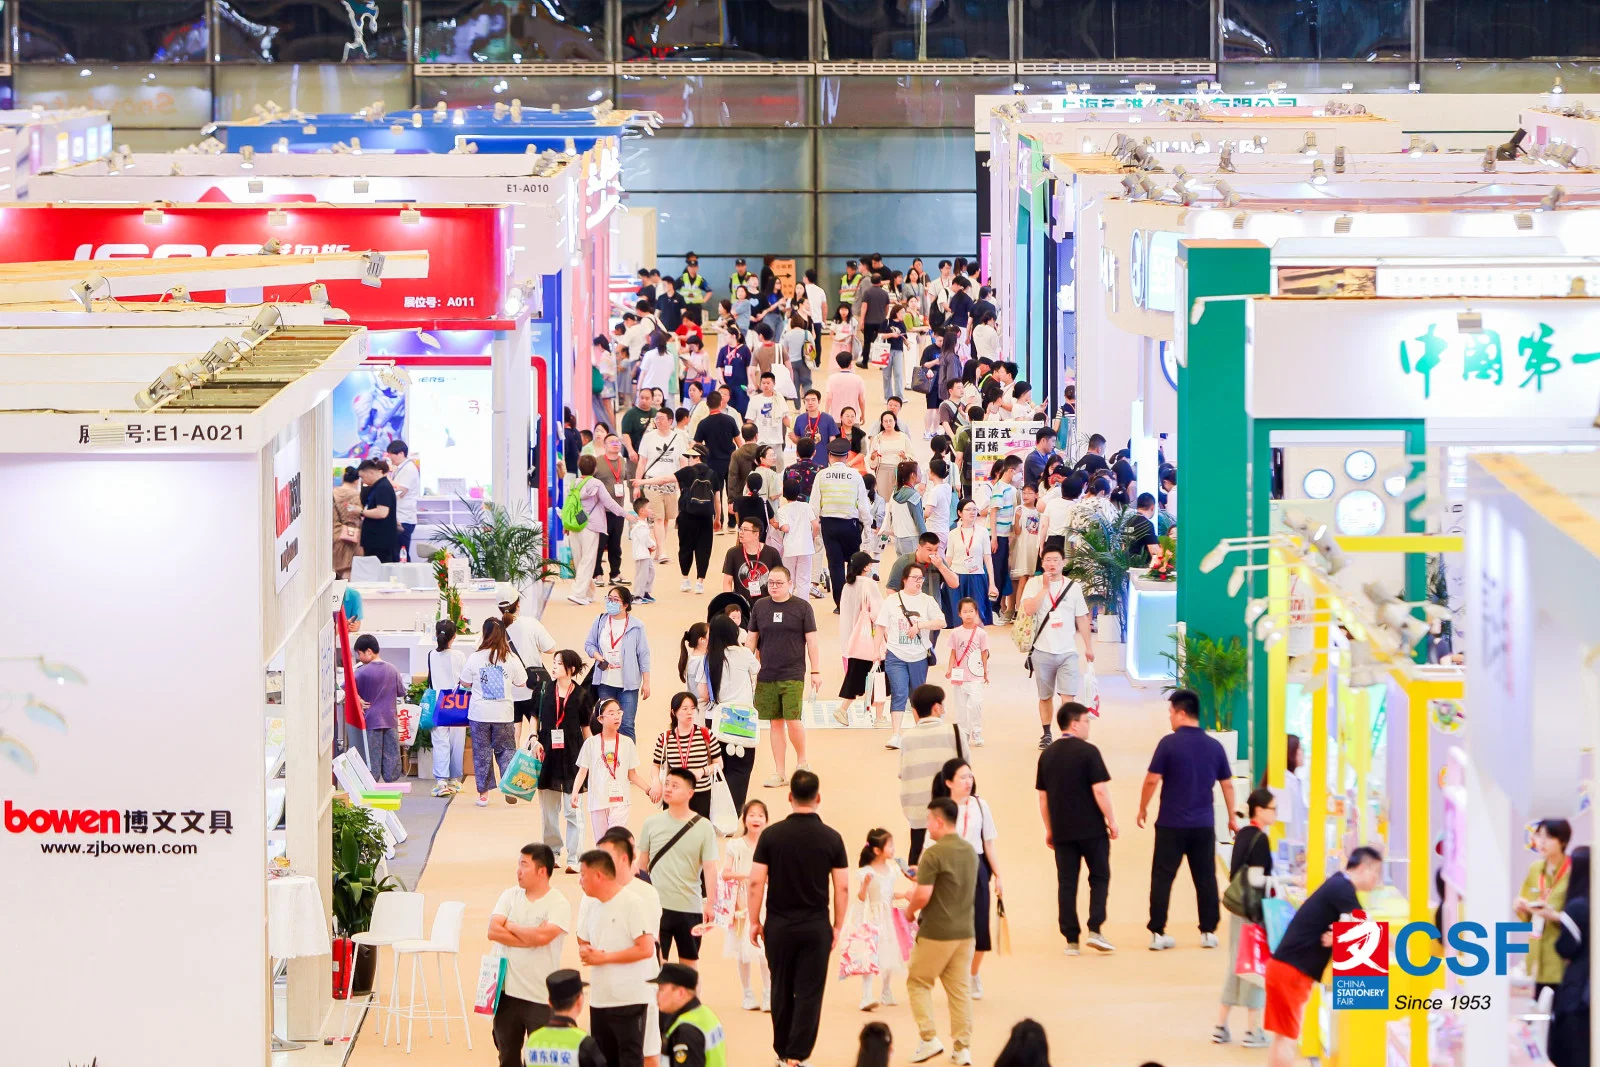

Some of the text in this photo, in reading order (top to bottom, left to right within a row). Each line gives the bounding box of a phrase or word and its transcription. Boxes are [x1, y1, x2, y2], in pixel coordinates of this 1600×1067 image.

[507, 184, 549, 193] E1-A010
[78, 424, 243, 444] 展号:E1-A021
[975, 428, 1011, 438] 直液式
[975, 441, 999, 452] 丙烯
[825, 472, 852, 480] SNIEC
[4, 800, 234, 835] bowen 博文文具
[40, 841, 198, 856] www.zjbowen.com
[528, 1049, 572, 1065] 浦东保安
